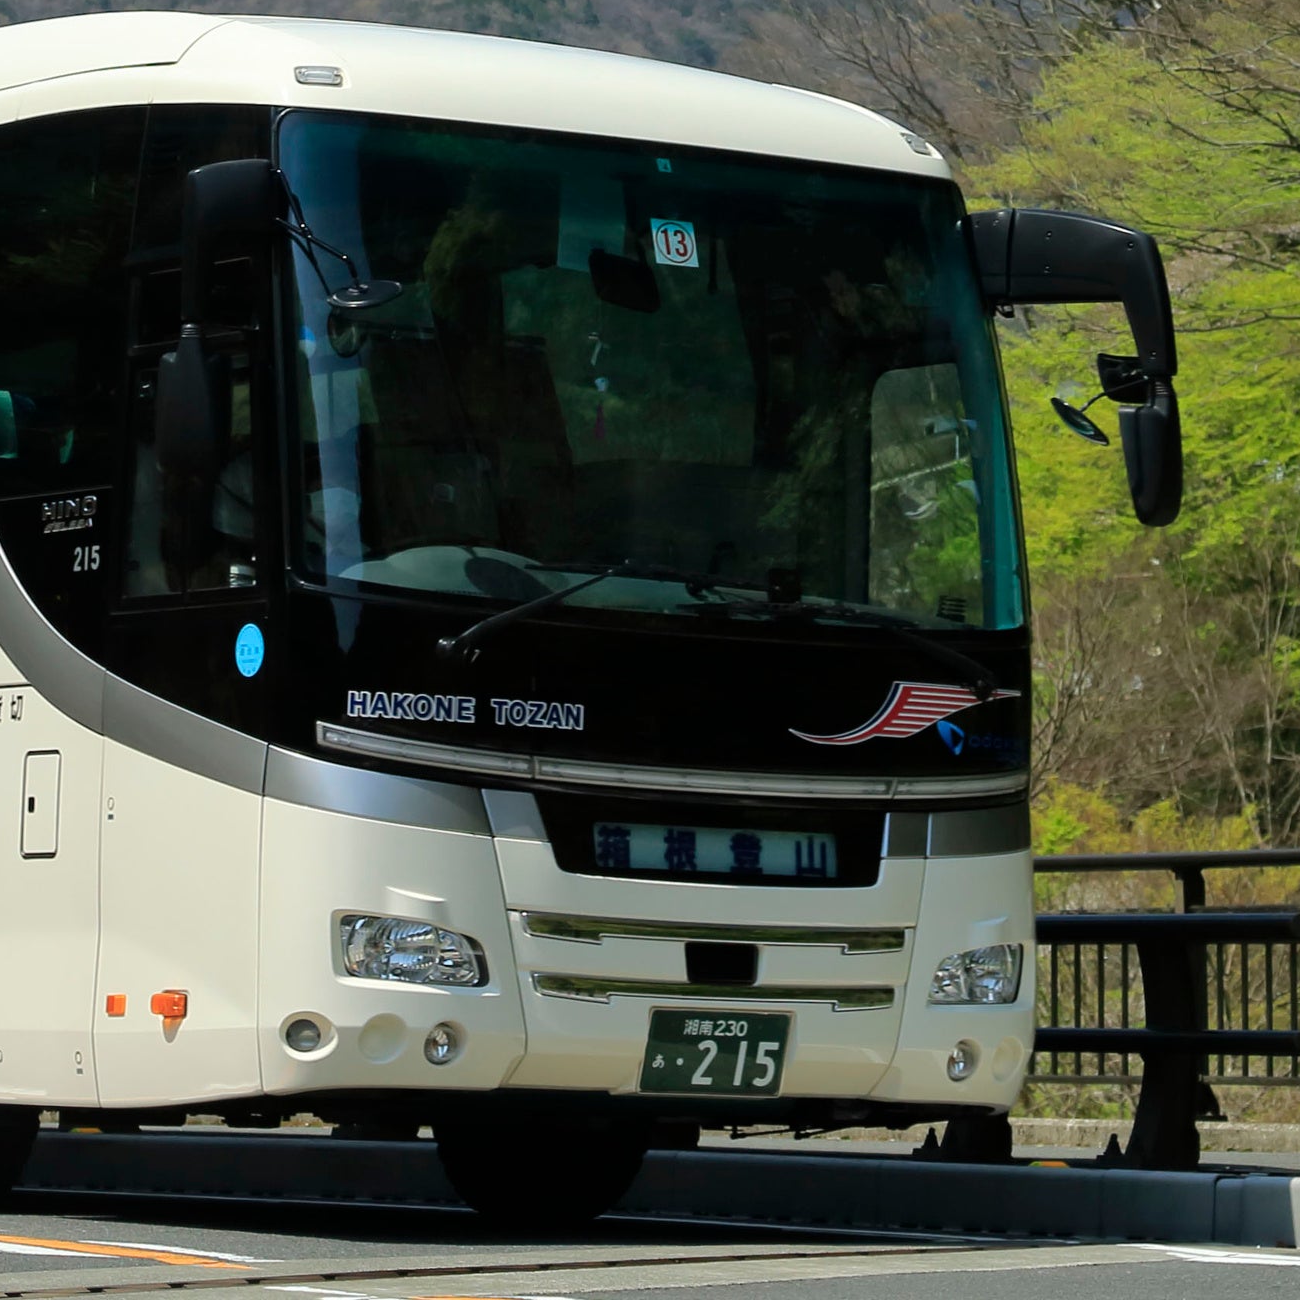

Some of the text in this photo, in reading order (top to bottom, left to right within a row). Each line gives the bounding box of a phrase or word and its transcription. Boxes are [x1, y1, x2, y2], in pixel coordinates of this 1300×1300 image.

[660, 227, 688, 258] 13
[42, 495, 97, 520] HINO
[73, 545, 101, 572] 215
[347, 690, 585, 730] HAKONE TOZAN
